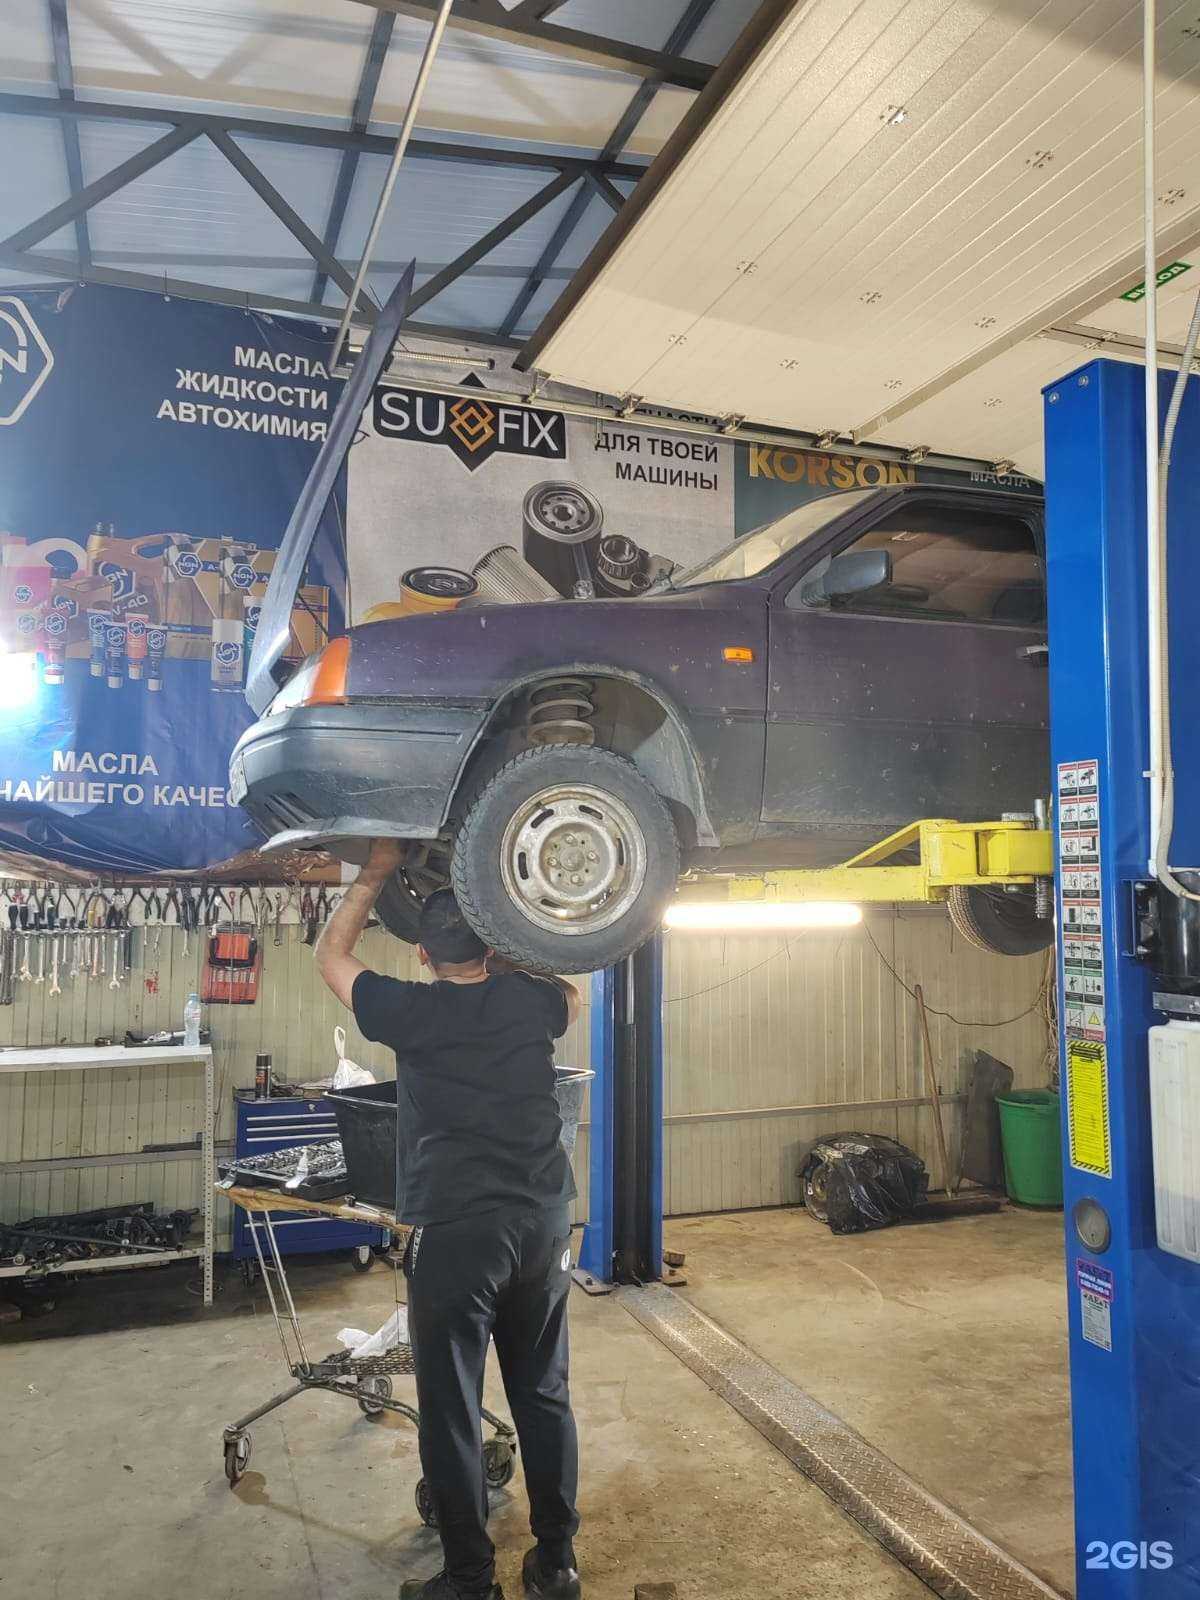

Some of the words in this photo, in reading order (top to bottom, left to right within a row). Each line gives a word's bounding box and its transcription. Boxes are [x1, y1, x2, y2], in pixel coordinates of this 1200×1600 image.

[1126, 265, 1186, 299] ВЫОД
[234, 345, 329, 380] МАСЛА
[175, 368, 328, 410] ЖИДКОСТИ
[156, 399, 328, 442] АВТОХИМИЯ
[594, 431, 640, 453] ДЛЯ
[647, 437, 718, 463] ТВОЕЙ
[615, 461, 718, 491] МАШИНЫ
[749, 442, 917, 488] KORSON
[52, 750, 159, 776] МАСЛА
